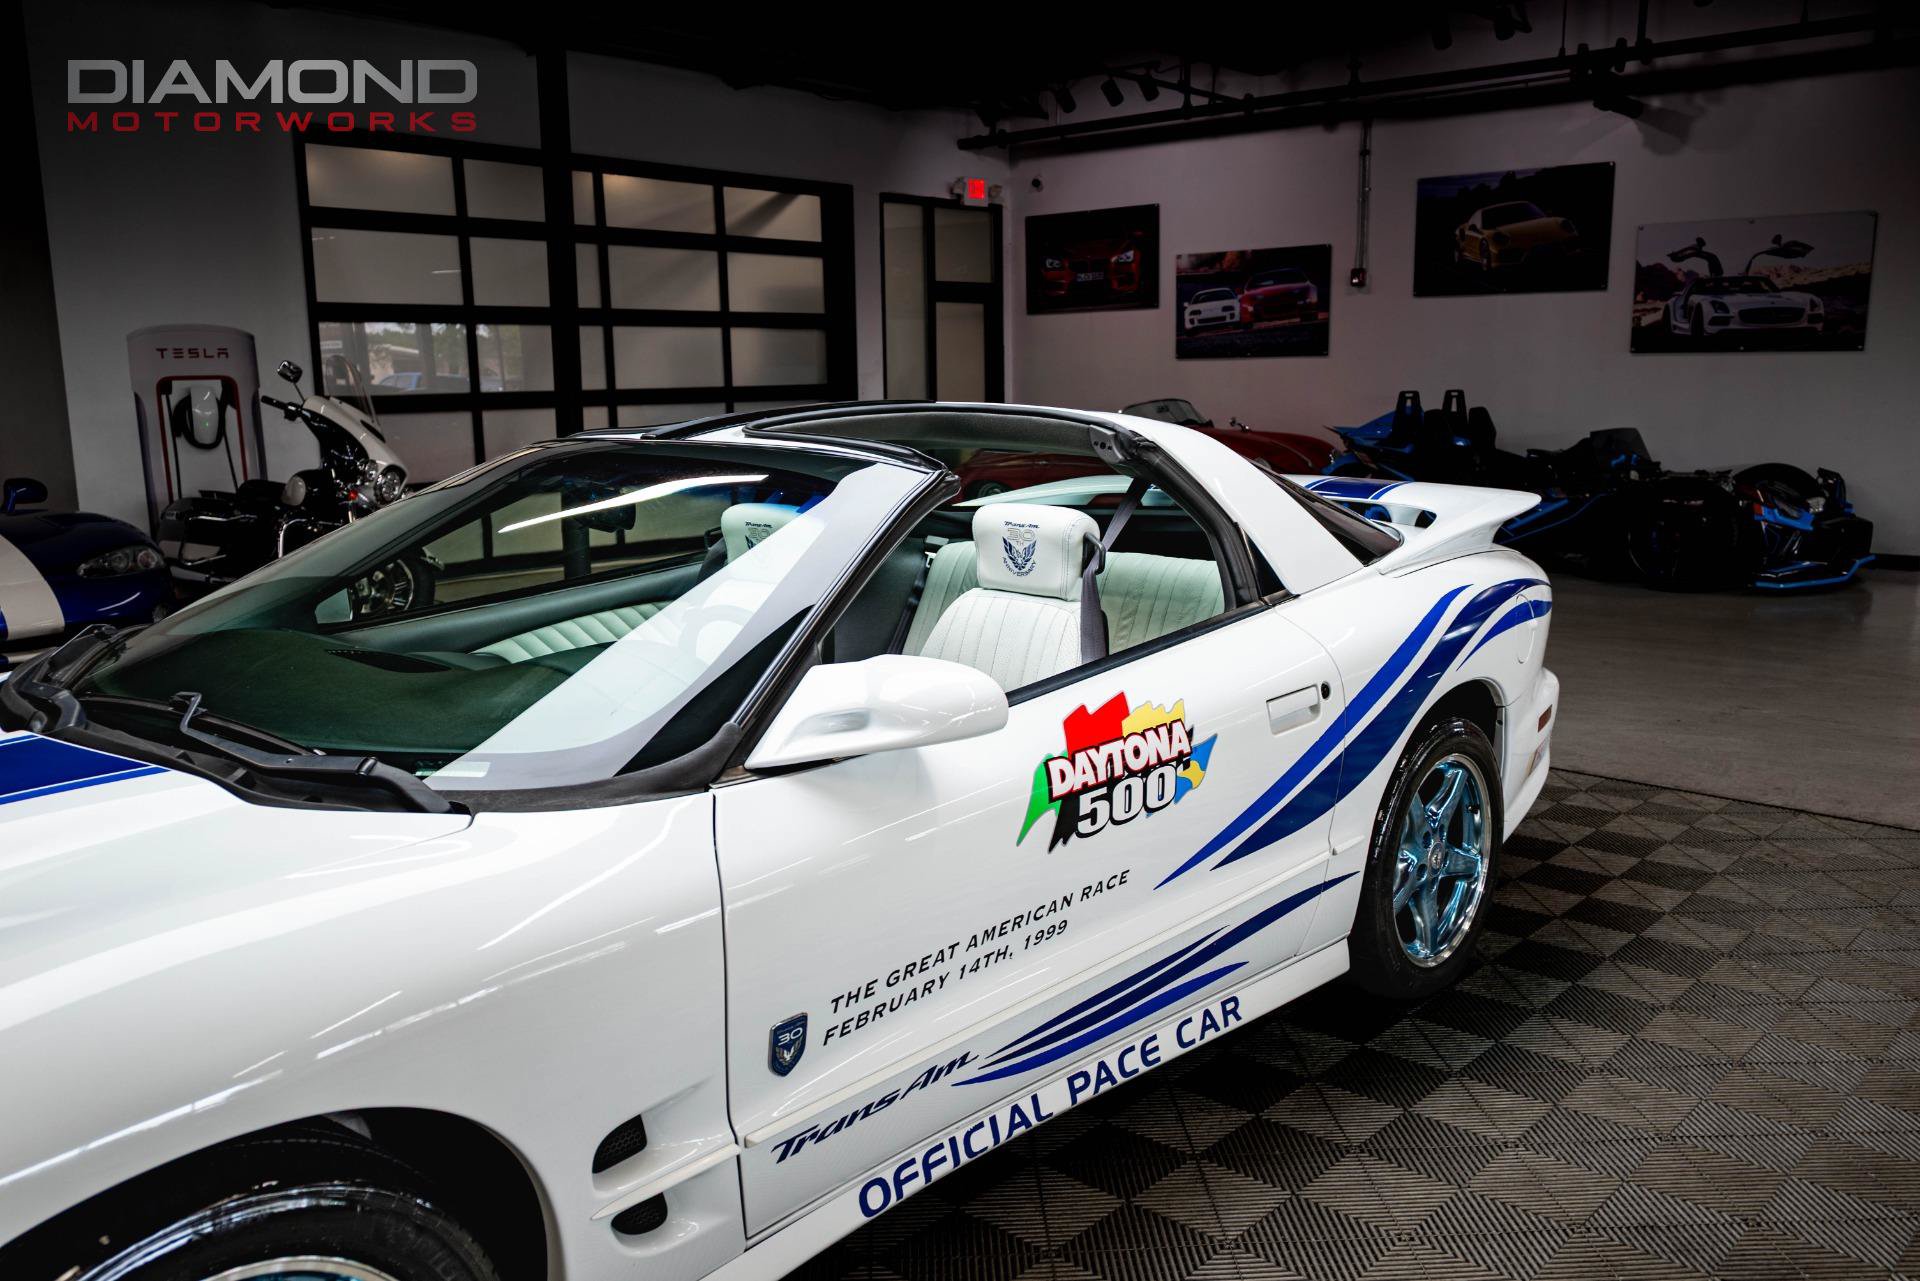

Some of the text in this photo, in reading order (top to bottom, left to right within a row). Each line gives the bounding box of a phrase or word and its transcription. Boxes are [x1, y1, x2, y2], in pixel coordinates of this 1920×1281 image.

[155, 348, 229, 359] TESLA
[1007, 528, 1035, 541] 30
[1046, 720, 1191, 800] DAYTONA
[1076, 764, 1177, 836] 500
[831, 870, 1130, 1014] THE GREAT AMERICAN RACE
[823, 920, 1067, 1046] FEBRUARY 14TH, 1999
[778, 1027, 803, 1045] 30
[771, 1051, 979, 1164] Trans Am
[859, 996, 1242, 1217] OFFICIAL PACE CAR
